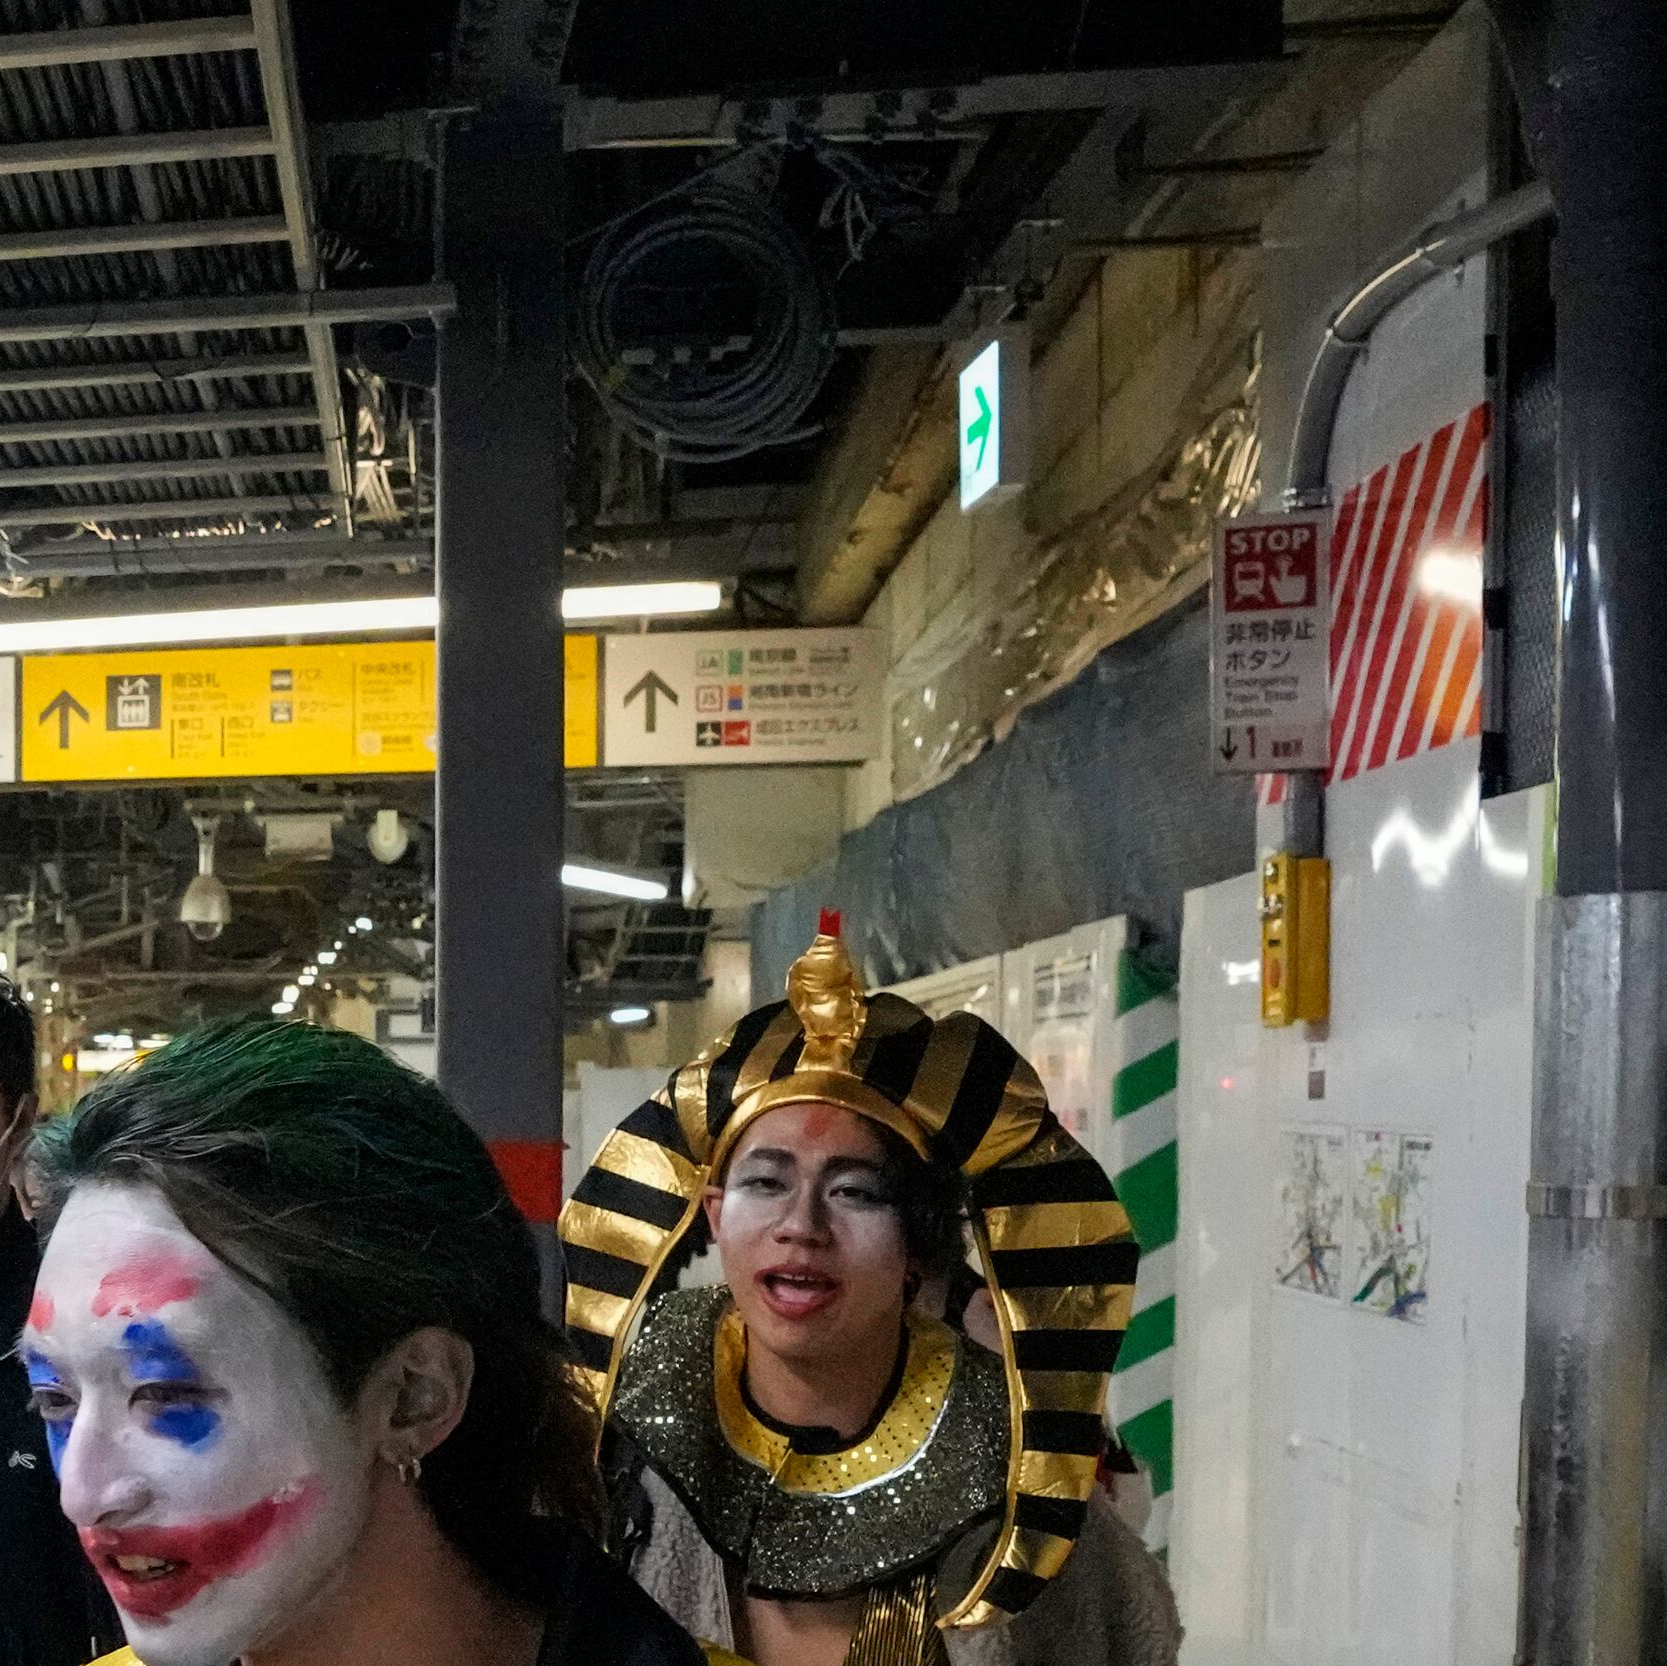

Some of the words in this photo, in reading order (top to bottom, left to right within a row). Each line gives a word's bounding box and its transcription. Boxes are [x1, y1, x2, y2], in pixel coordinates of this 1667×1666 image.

[1229, 527, 1311, 554] STOP
[1225, 618, 1316, 645] 非常停止
